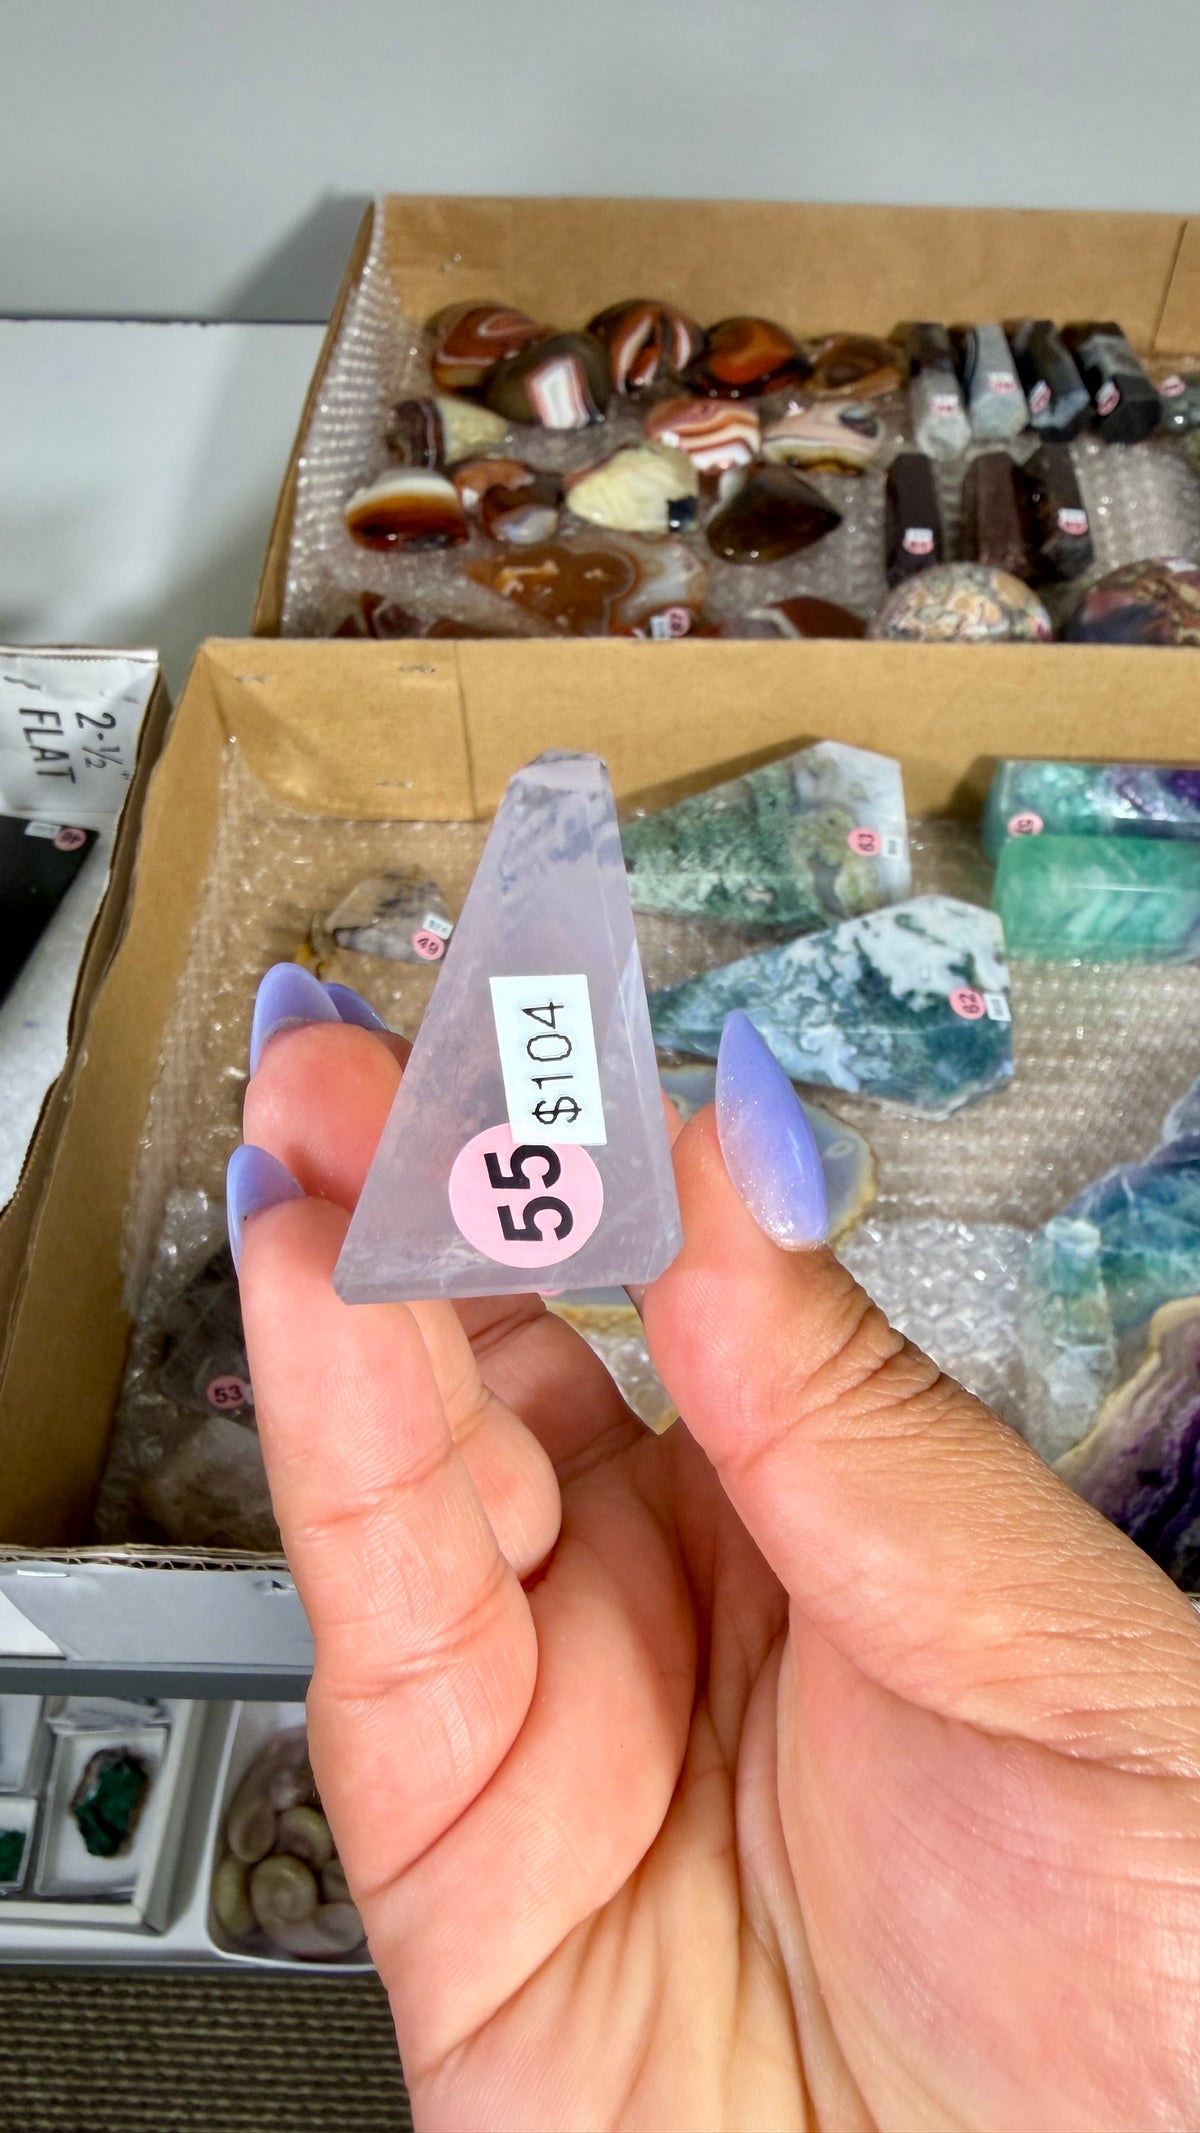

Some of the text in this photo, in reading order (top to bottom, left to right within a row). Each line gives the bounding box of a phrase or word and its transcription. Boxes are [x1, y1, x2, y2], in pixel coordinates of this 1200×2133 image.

[19, 707, 76, 784] FLAT
[521, 998, 583, 1125] $104
[484, 1144, 574, 1241] 55
[214, 1385, 243, 1404] 53
